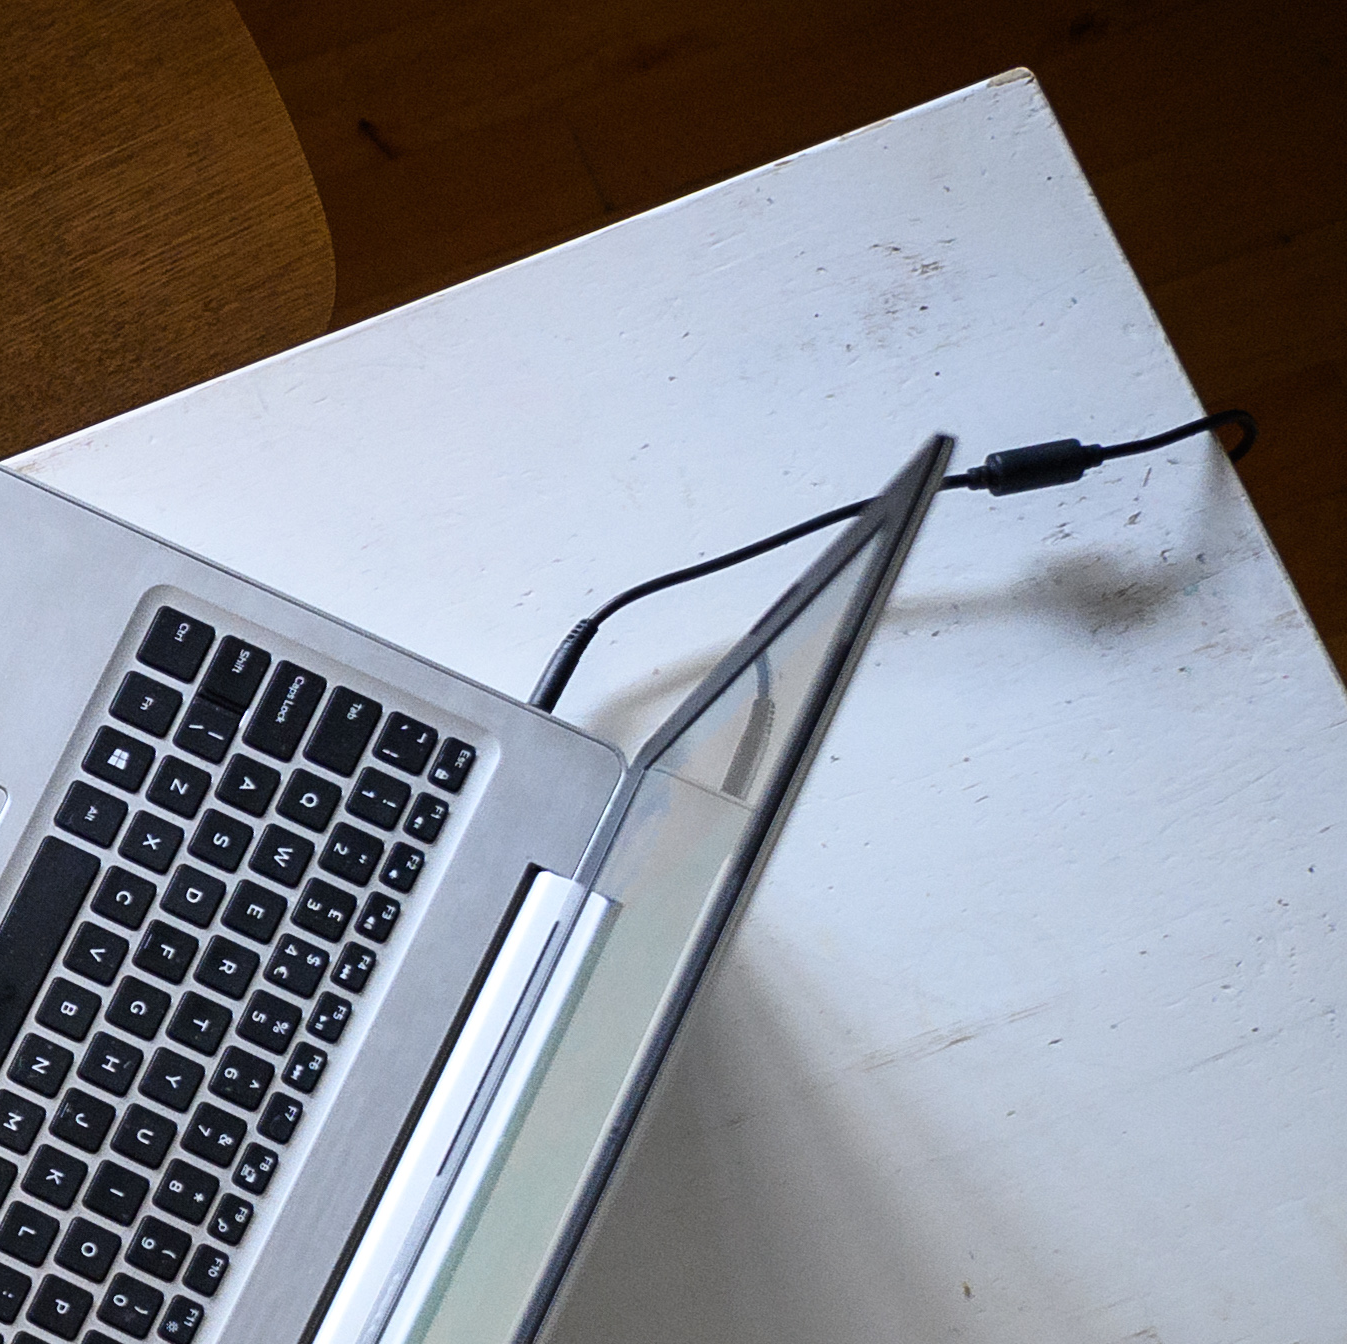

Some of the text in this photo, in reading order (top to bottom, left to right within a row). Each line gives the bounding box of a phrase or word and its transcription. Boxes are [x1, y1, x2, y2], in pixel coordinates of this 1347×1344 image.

[173, 622, 190, 642] Ctrl
[230, 648, 250, 673] Shift
[139, 696, 154, 710] Fn
[274, 675, 304, 723] Caps Lock
[346, 703, 362, 720] Tab
[453, 749, 471, 768] Esc
[169, 777, 188, 795] Z
[238, 775, 255, 790] A
[298, 792, 318, 808] Q
[360, 790, 374, 798] 1
[83, 805, 97, 821] Alt
[429, 804, 444, 819] F1
[141, 833, 161, 850] X
[212, 832, 229, 848] S
[332, 842, 348, 855] 2
[272, 847, 293, 867] W
[405, 854, 420, 870] F2
[115, 890, 132, 905] C
[185, 887, 203, 903] D
[245, 903, 264, 919] E
[305, 897, 321, 911] 3
[380, 904, 396, 920] F3
[326, 908, 343, 922] £
[88, 948, 105, 962] V
[159, 943, 175, 959] F
[283, 943, 297, 956] 4
[217, 958, 237, 974] R
[305, 953, 321, 967] $
[356, 954, 371, 970] F4
[272, 965, 287, 979] €
[59, 1000, 78, 1016] B
[129, 1000, 146, 1015] G
[332, 1005, 347, 1020] F5
[250, 1010, 266, 1023] 5
[192, 1018, 209, 1032] T
[271, 1020, 289, 1035] %
[30, 1056, 50, 1074] N
[100, 1054, 119, 1073] H
[307, 1054, 322, 1070] F6
[164, 1075, 181, 1088] Y
[223, 1067, 238, 1080] 6
[2, 1111, 22, 1131] M
[74, 1112, 88, 1128] J
[283, 1105, 297, 1122] F7
[135, 1128, 153, 1145] U
[197, 1124, 210, 1137] 7
[216, 1133, 233, 1146] &
[258, 1155, 273, 1171] F8
[44, 1168, 64, 1185] K
[108, 1187, 124, 1197] I
[168, 1179, 183, 1193] 8
[233, 1206, 248, 1223] F9
[17, 1225, 36, 1236] L
[80, 1241, 97, 1257] O
[140, 1236, 155, 1250] 9
[207, 1257, 224, 1277] F10
[54, 1298, 70, 1314] P
[112, 1293, 127, 1307] 0
[182, 1308, 199, 1327] F11
